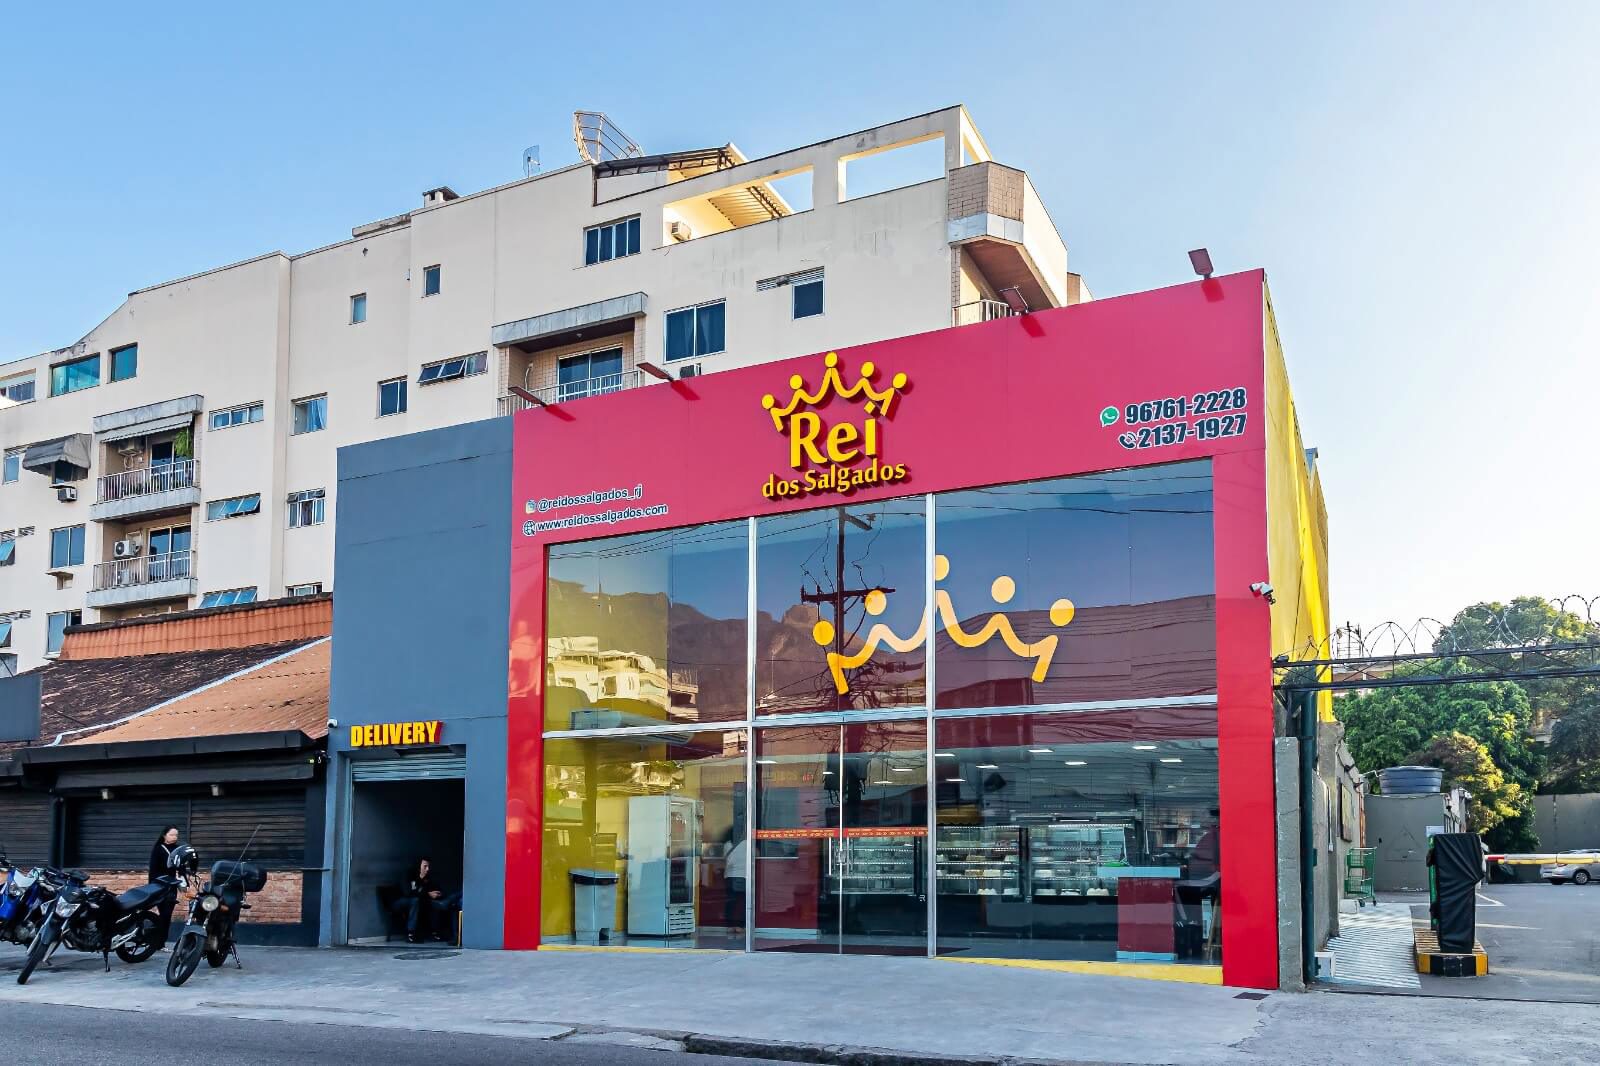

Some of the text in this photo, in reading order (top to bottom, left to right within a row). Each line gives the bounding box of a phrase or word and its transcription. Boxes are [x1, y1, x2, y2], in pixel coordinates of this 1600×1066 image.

[1126, 388, 1247, 424] 96761-2228
[790, 401, 876, 468] Rei
[1138, 414, 1247, 448] 2137-1927
[762, 458, 906, 497] dos Salgados
[538, 484, 642, 511] @reidossalgados_rj
[350, 721, 441, 747] DELIVERY
